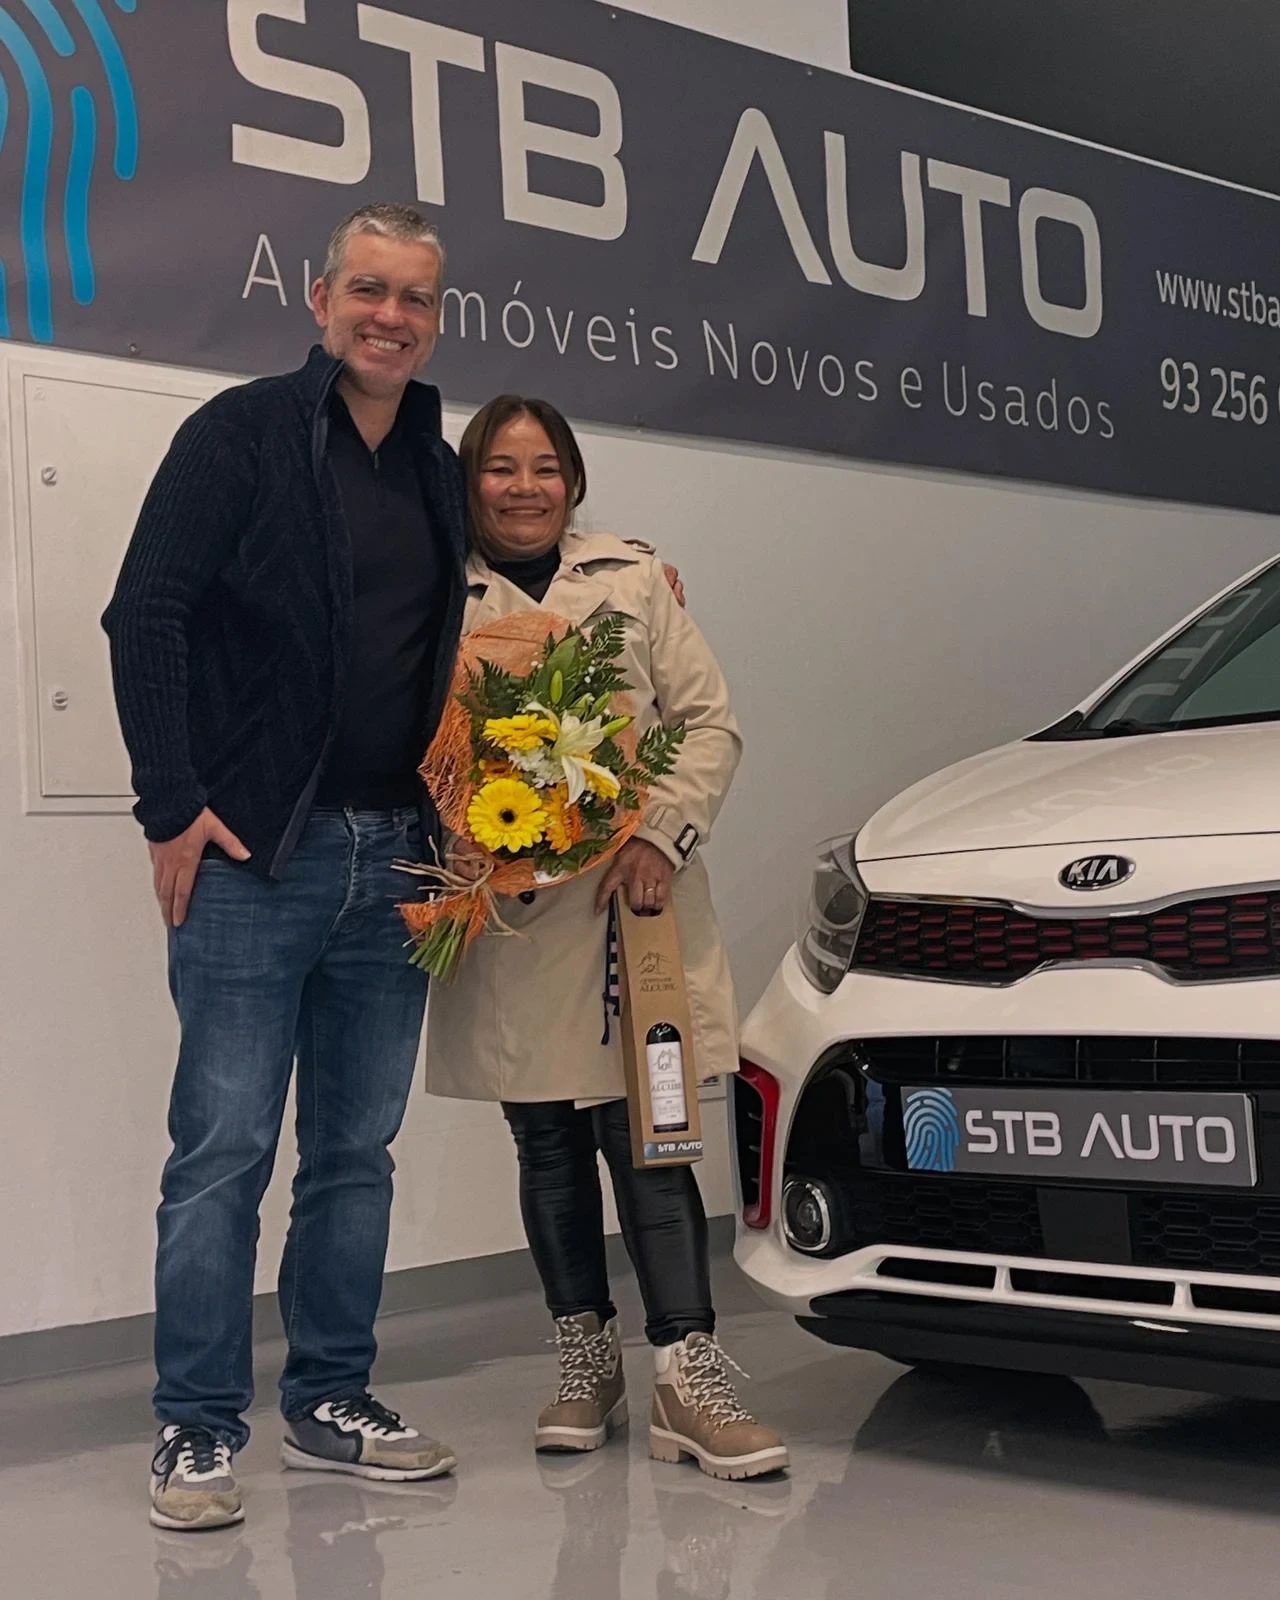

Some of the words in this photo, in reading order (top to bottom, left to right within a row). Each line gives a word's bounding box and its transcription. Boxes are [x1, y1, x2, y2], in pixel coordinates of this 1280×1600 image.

[226, 0, 628, 241] STB
[691, 107, 1103, 338] AUTO
[1156, 269, 1280, 328] www.stba
[242, 233, 680, 370] Amóveis
[702, 319, 879, 402] Novos
[900, 366, 923, 408] e
[942, 361, 1116, 439] Usados
[1160, 357, 1201, 414] 93
[1210, 367, 1269, 425] 256
[1066, 859, 1118, 882] KIA
[657, 1143, 676, 1153] STB
[677, 1141, 703, 1151] AUTO
[965, 1109, 1062, 1156] STB
[1080, 1112, 1236, 1164] AUTO
